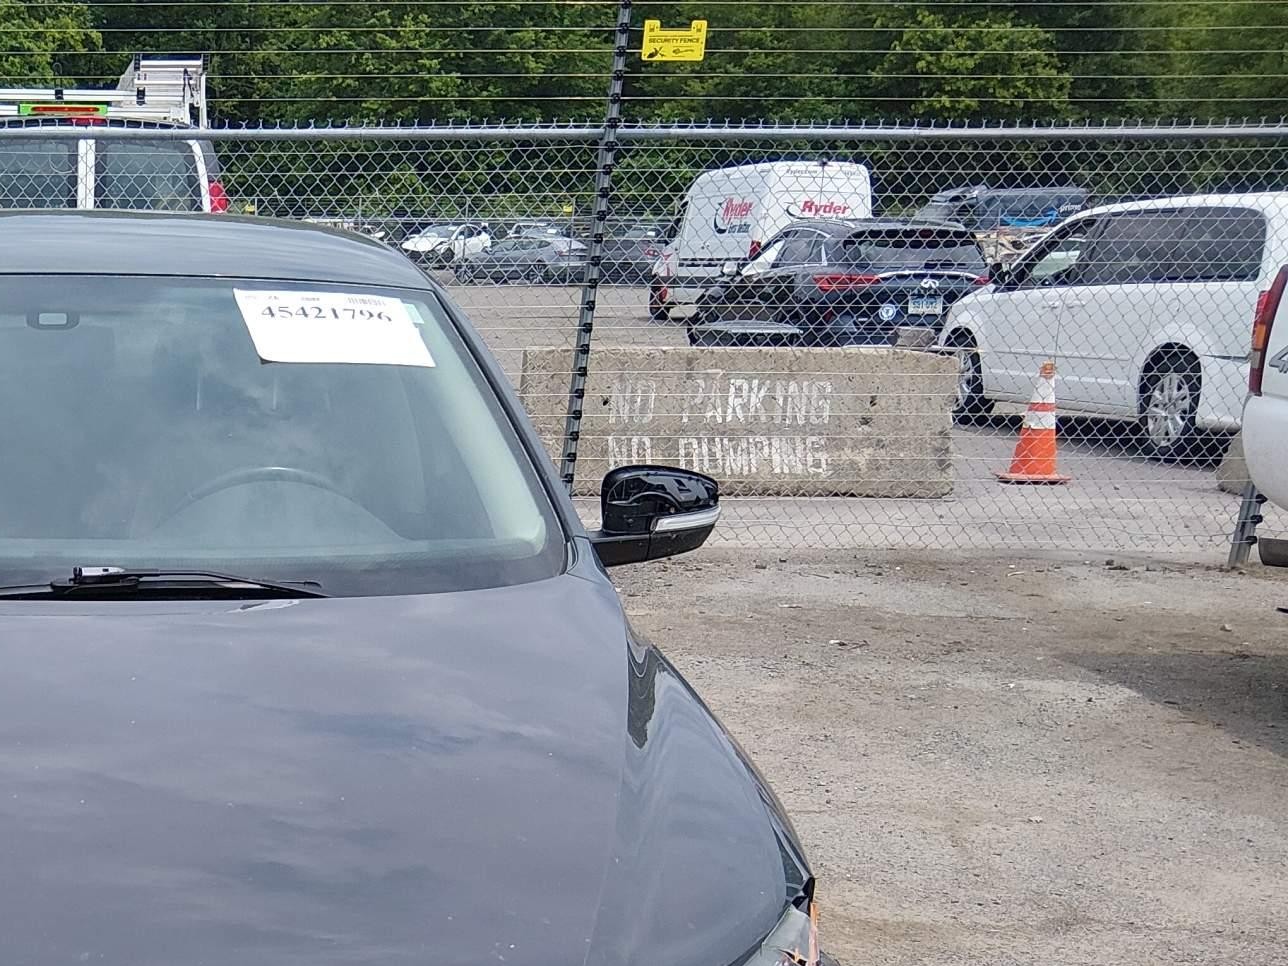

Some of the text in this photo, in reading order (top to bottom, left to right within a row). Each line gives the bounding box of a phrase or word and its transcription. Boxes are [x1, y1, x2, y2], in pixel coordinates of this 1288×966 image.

[723, 198, 753, 224] Ryder
[801, 200, 849, 216] Ryder
[261, 305, 393, 323] 45421796
[608, 379, 833, 425] NO PARKING
[678, 435, 833, 477] DUMPING
